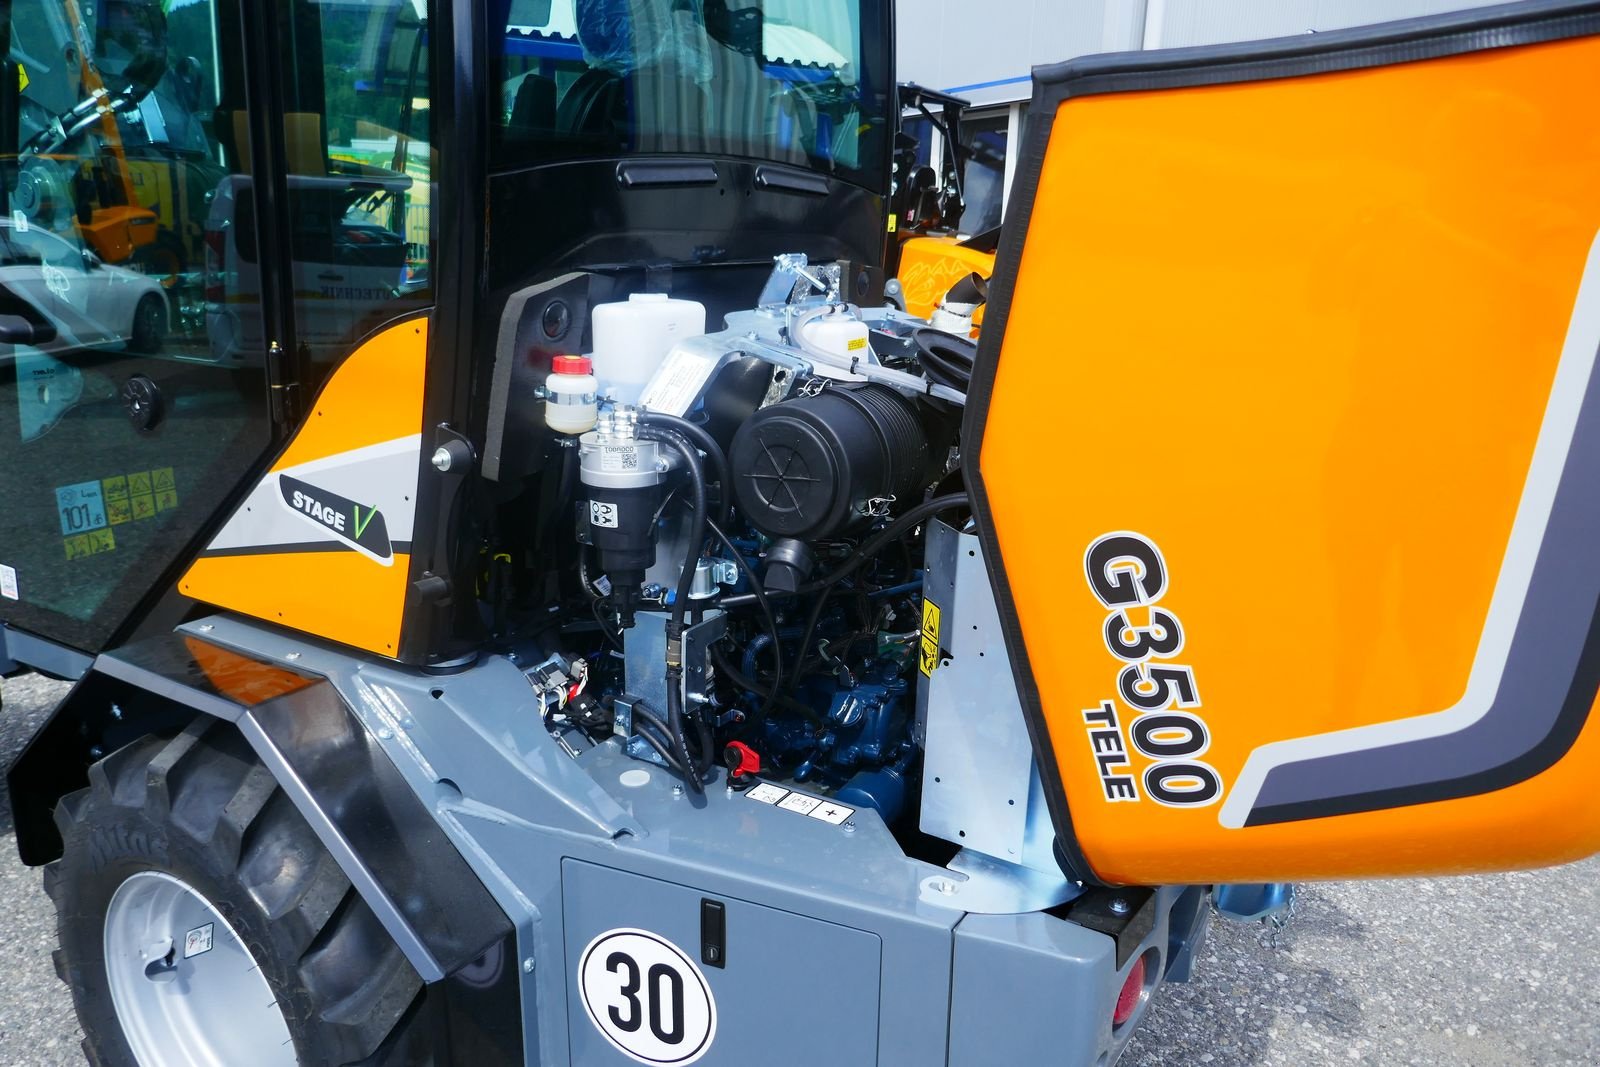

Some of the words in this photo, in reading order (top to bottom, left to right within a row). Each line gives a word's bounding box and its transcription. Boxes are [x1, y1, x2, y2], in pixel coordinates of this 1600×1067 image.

[62, 503, 91, 531] 101
[293, 490, 346, 532] STAGE
[353, 504, 377, 540] V
[1084, 531, 1224, 809] G3500
[1082, 700, 1140, 802] TELE
[606, 951, 685, 1045] 30
